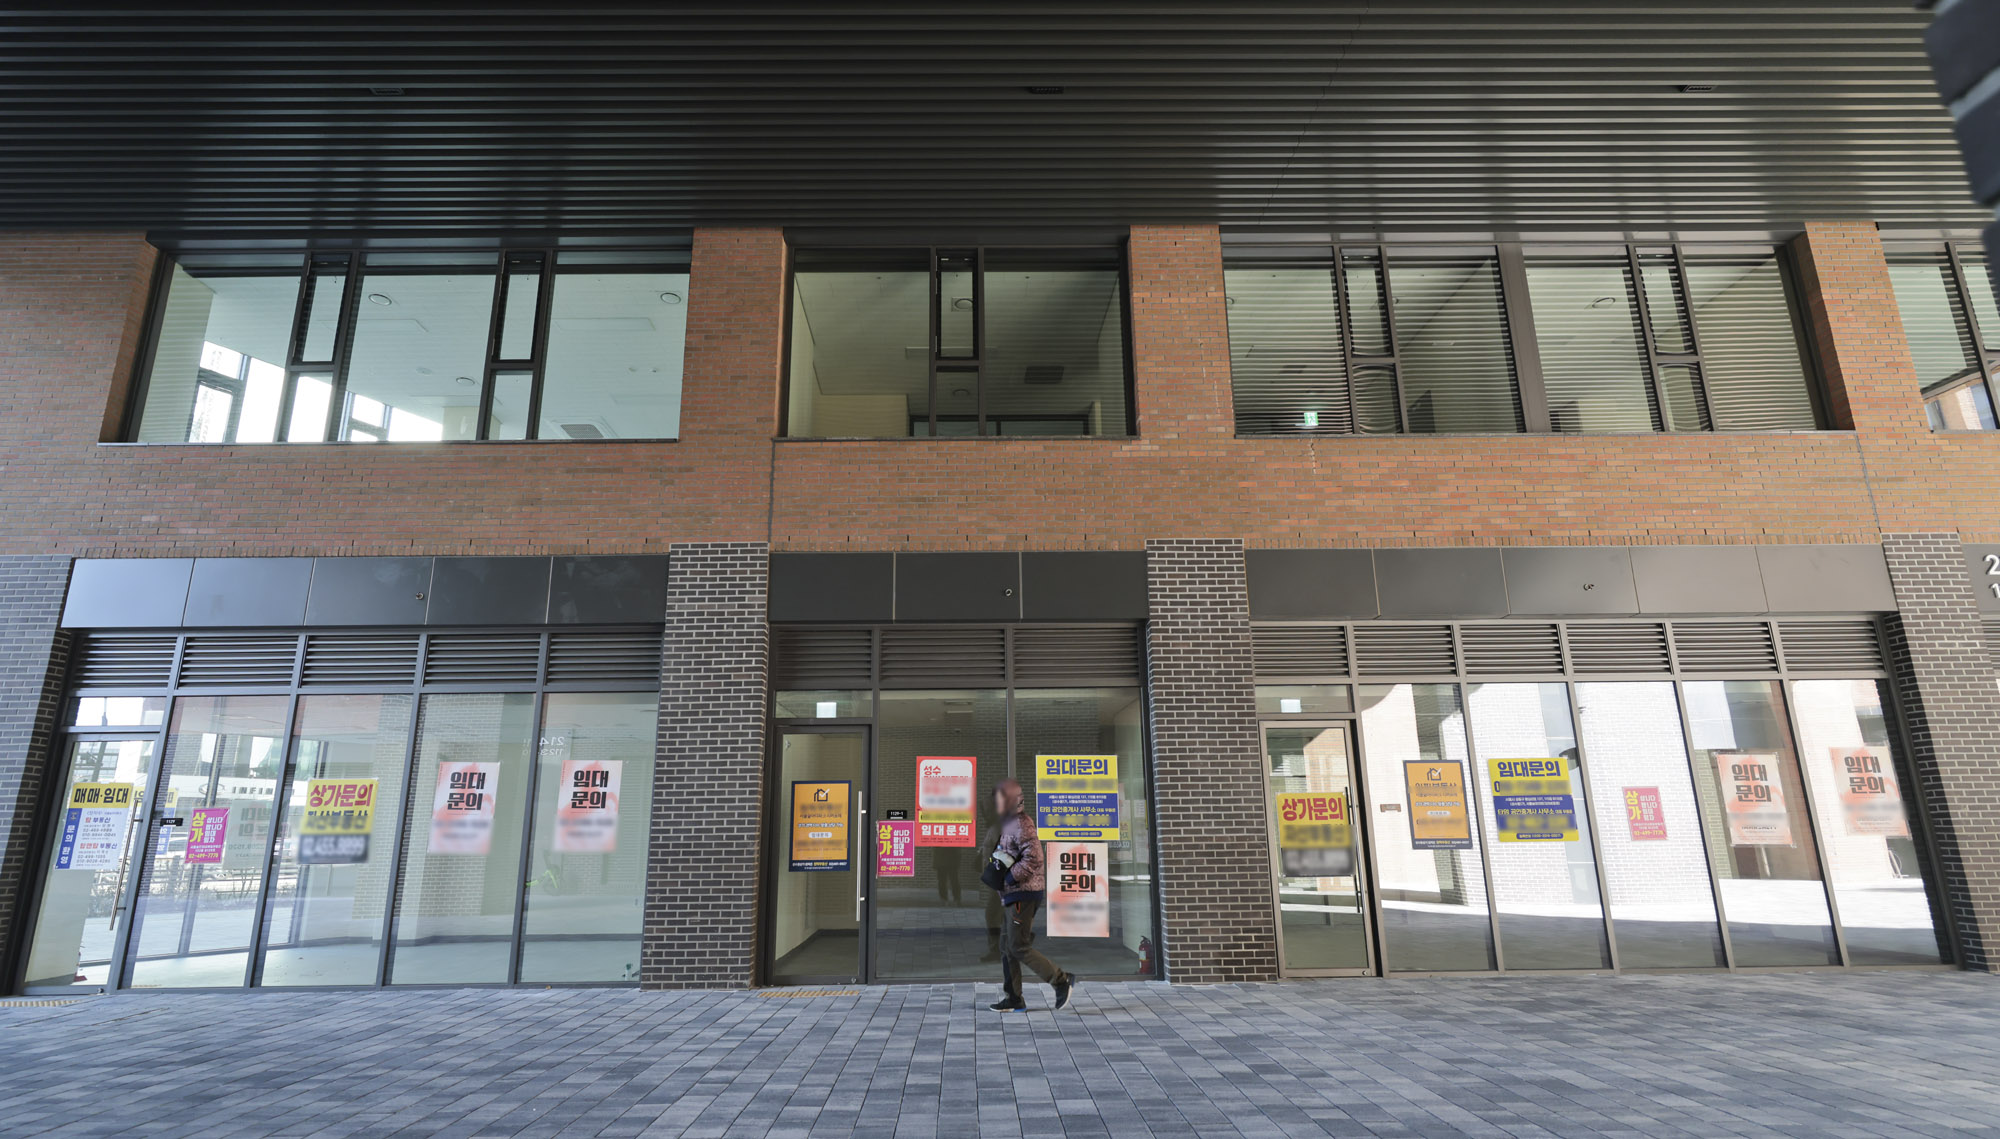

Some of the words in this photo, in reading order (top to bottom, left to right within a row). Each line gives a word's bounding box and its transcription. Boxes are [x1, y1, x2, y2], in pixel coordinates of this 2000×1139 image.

[923, 765, 942, 776] 성수
[1046, 759, 1108, 775] 임대문의
[1497, 761, 1561, 777] 임대문의
[1731, 764, 1768, 782] 임대
[1844, 756, 1881, 773] 임대
[450, 771, 485, 790] 임대
[573, 769, 609, 788] 임대
[1849, 776, 1886, 794] 문의
[73, 787, 130, 804] 매매·임대
[309, 783, 374, 807] 상가문의
[446, 792, 483, 811] 문의
[570, 791, 607, 809] 문의
[1735, 785, 1772, 803] 문의
[1282, 797, 1344, 821] 상가문의
[1625, 790, 1642, 820] 상가
[189, 812, 207, 843] 상가
[921, 824, 969, 836] 임대문의
[879, 824, 893, 855] 상가
[1060, 852, 1096, 871] 임대
[1059, 873, 1096, 893] 문의
